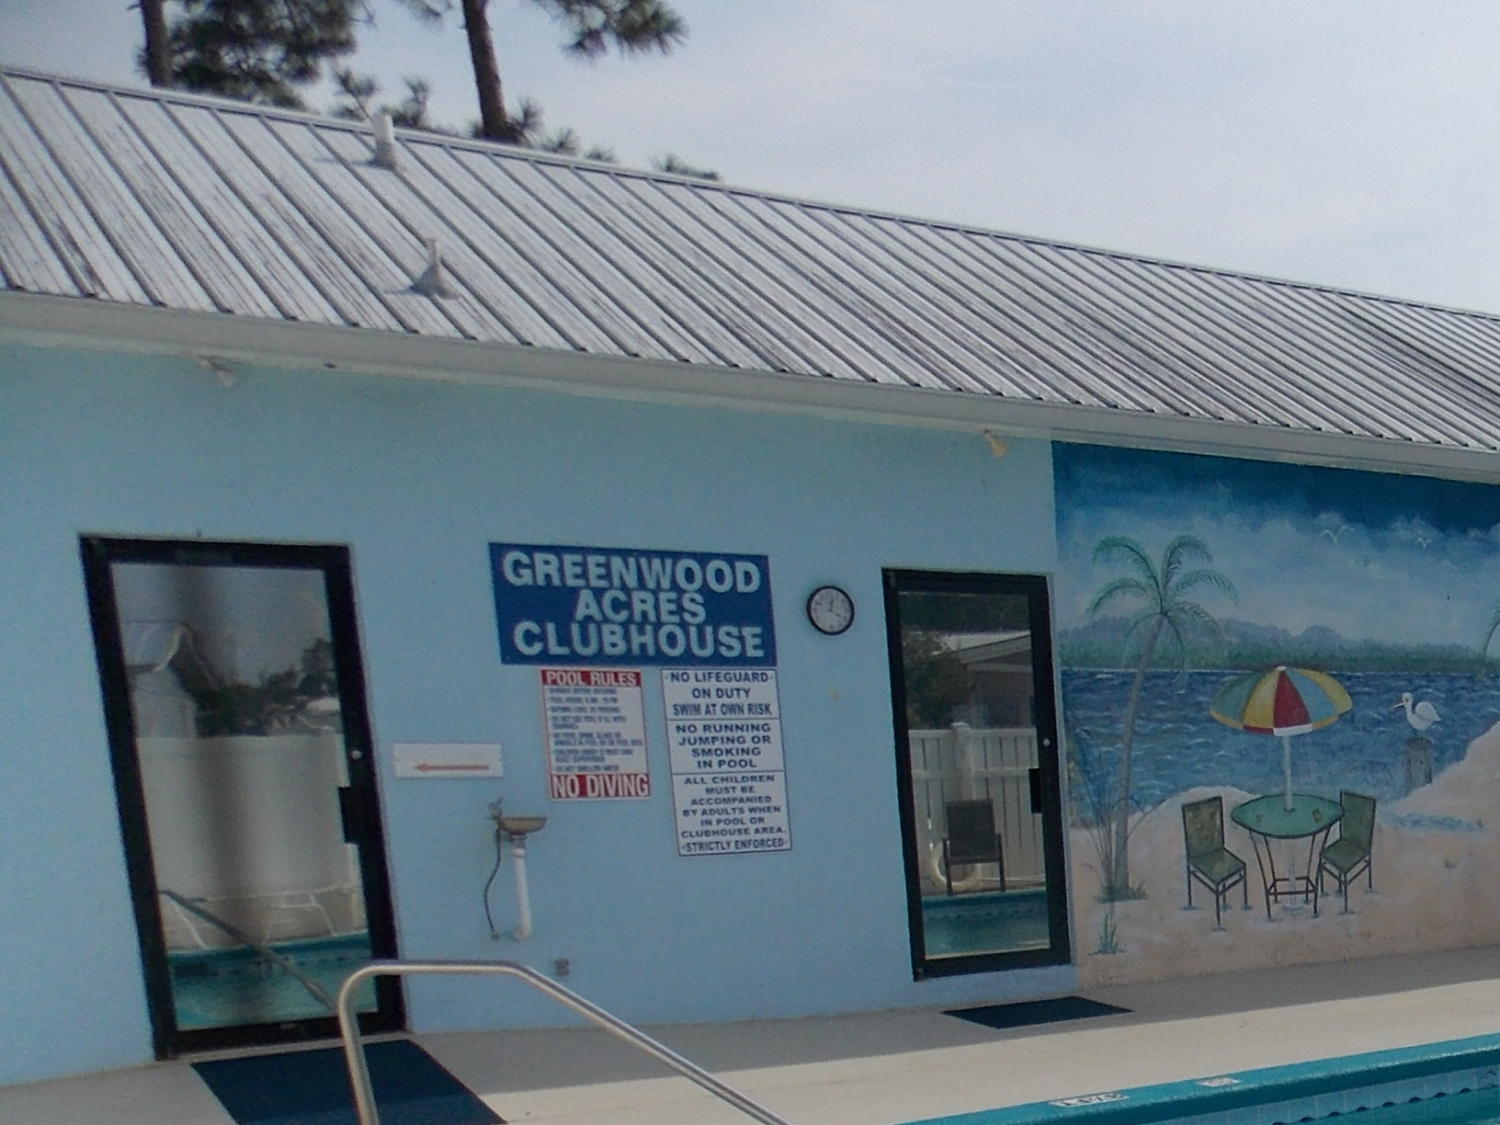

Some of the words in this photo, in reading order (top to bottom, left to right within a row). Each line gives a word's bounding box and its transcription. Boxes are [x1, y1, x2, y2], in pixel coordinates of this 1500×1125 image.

[503, 551, 761, 593] GREENWOOD
[574, 588, 706, 624] ACRES
[513, 620, 764, 657] CLUBHOUSE
[546, 671, 585, 685] POOL
[590, 671, 637, 687] RULES
[670, 672, 690, 682] NO
[694, 672, 769, 682] LIFEGUARD
[692, 688, 711, 699] ON
[716, 688, 751, 699] DUTY
[673, 704, 701, 716] SWIM
[705, 703, 717, 716] AT
[720, 704, 745, 716] OWN
[748, 703, 772, 716] RISK
[675, 724, 697, 734] NO
[703, 723, 771, 733] RUNNING
[678, 736, 746, 746] JUMPING
[751, 735, 771, 744] OR
[691, 747, 761, 757] SMOKING
[697, 760, 713, 769] IN
[718, 759, 757, 768] POOL
[684, 777, 708, 785] ALL
[712, 775, 775, 784] CHILDREN
[552, 774, 580, 798] NO
[585, 774, 649, 798] DIVING
[705, 787, 736, 795] MUST
[691, 796, 772, 806] ACCOMPANIED
[682, 809, 698, 817] BY
[701, 807, 745, 816] ADULTS
[747, 806, 781, 814] WHEN
[716, 818, 746, 826] POOL
[749, 817, 765, 825] OR
[681, 828, 750, 839] CLUBHOUSE
